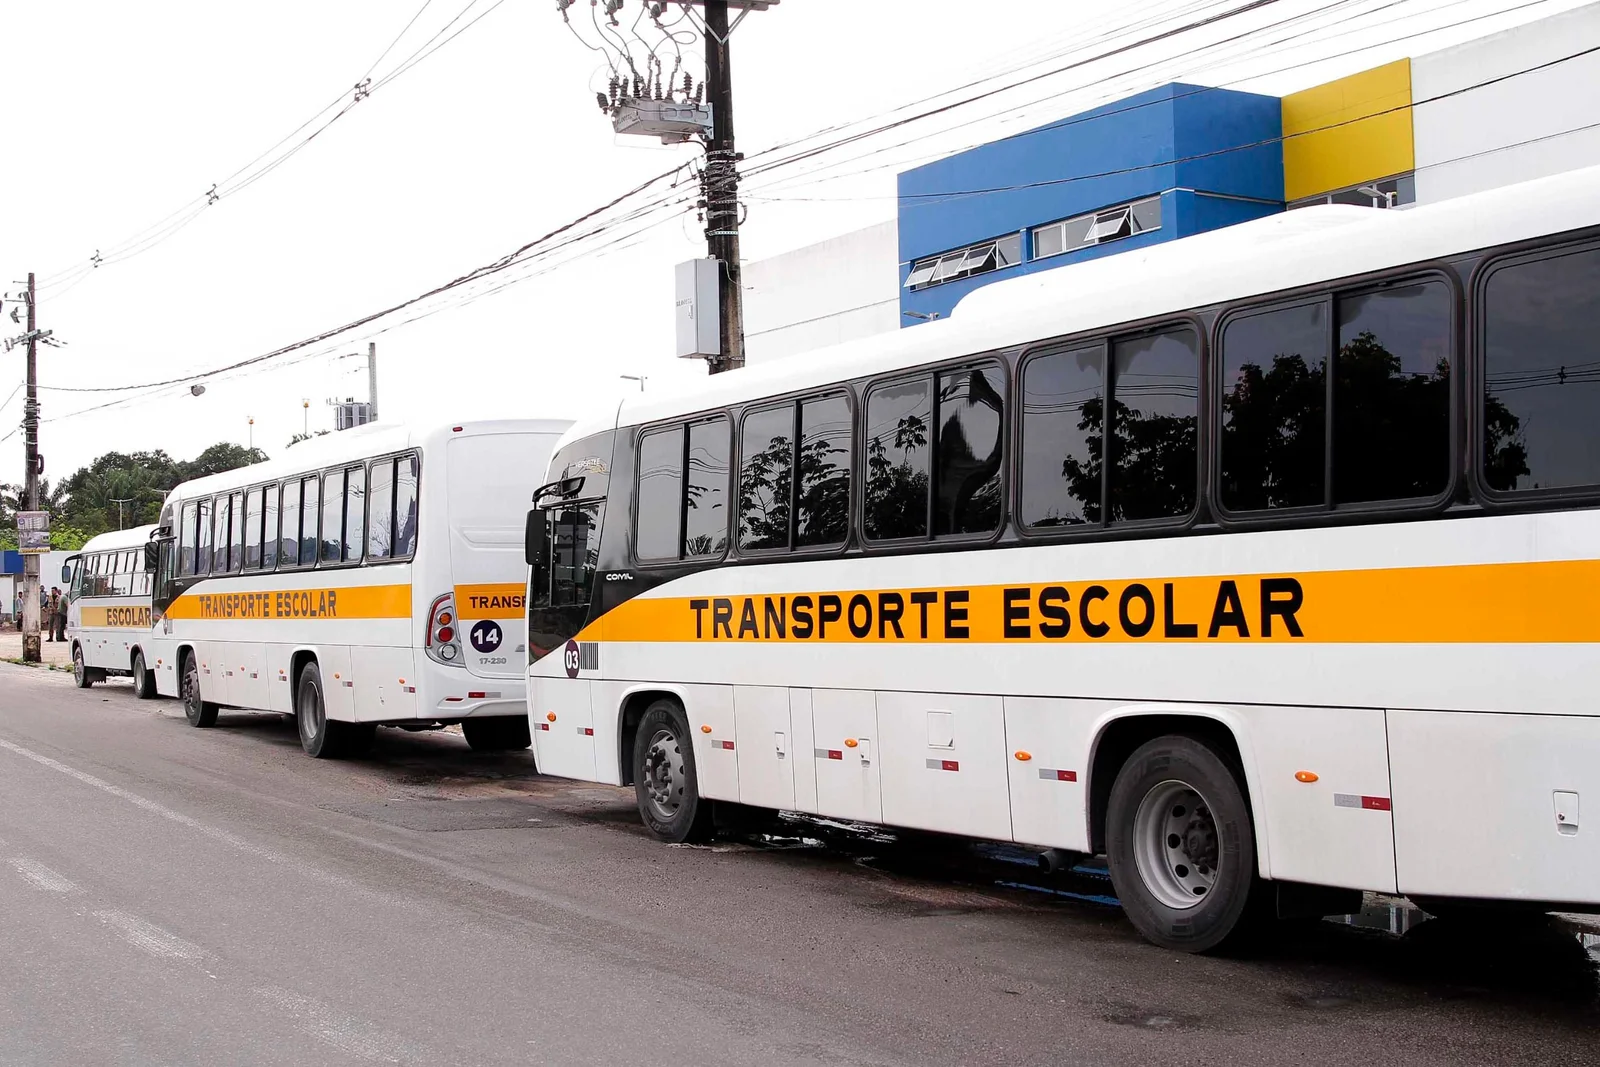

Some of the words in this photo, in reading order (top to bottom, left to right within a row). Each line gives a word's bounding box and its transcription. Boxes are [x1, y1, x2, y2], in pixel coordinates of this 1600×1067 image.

[606, 572, 633, 581] COMIL
[199, 593, 270, 618] TRANSPORTE
[276, 590, 337, 617] ESCOLAR
[690, 590, 970, 639] TRANSPORTE
[1003, 577, 1304, 638] ESCOLAR
[106, 607, 152, 626] ESCOLAR
[473, 628, 499, 645] 14
[566, 650, 579, 669] 03
